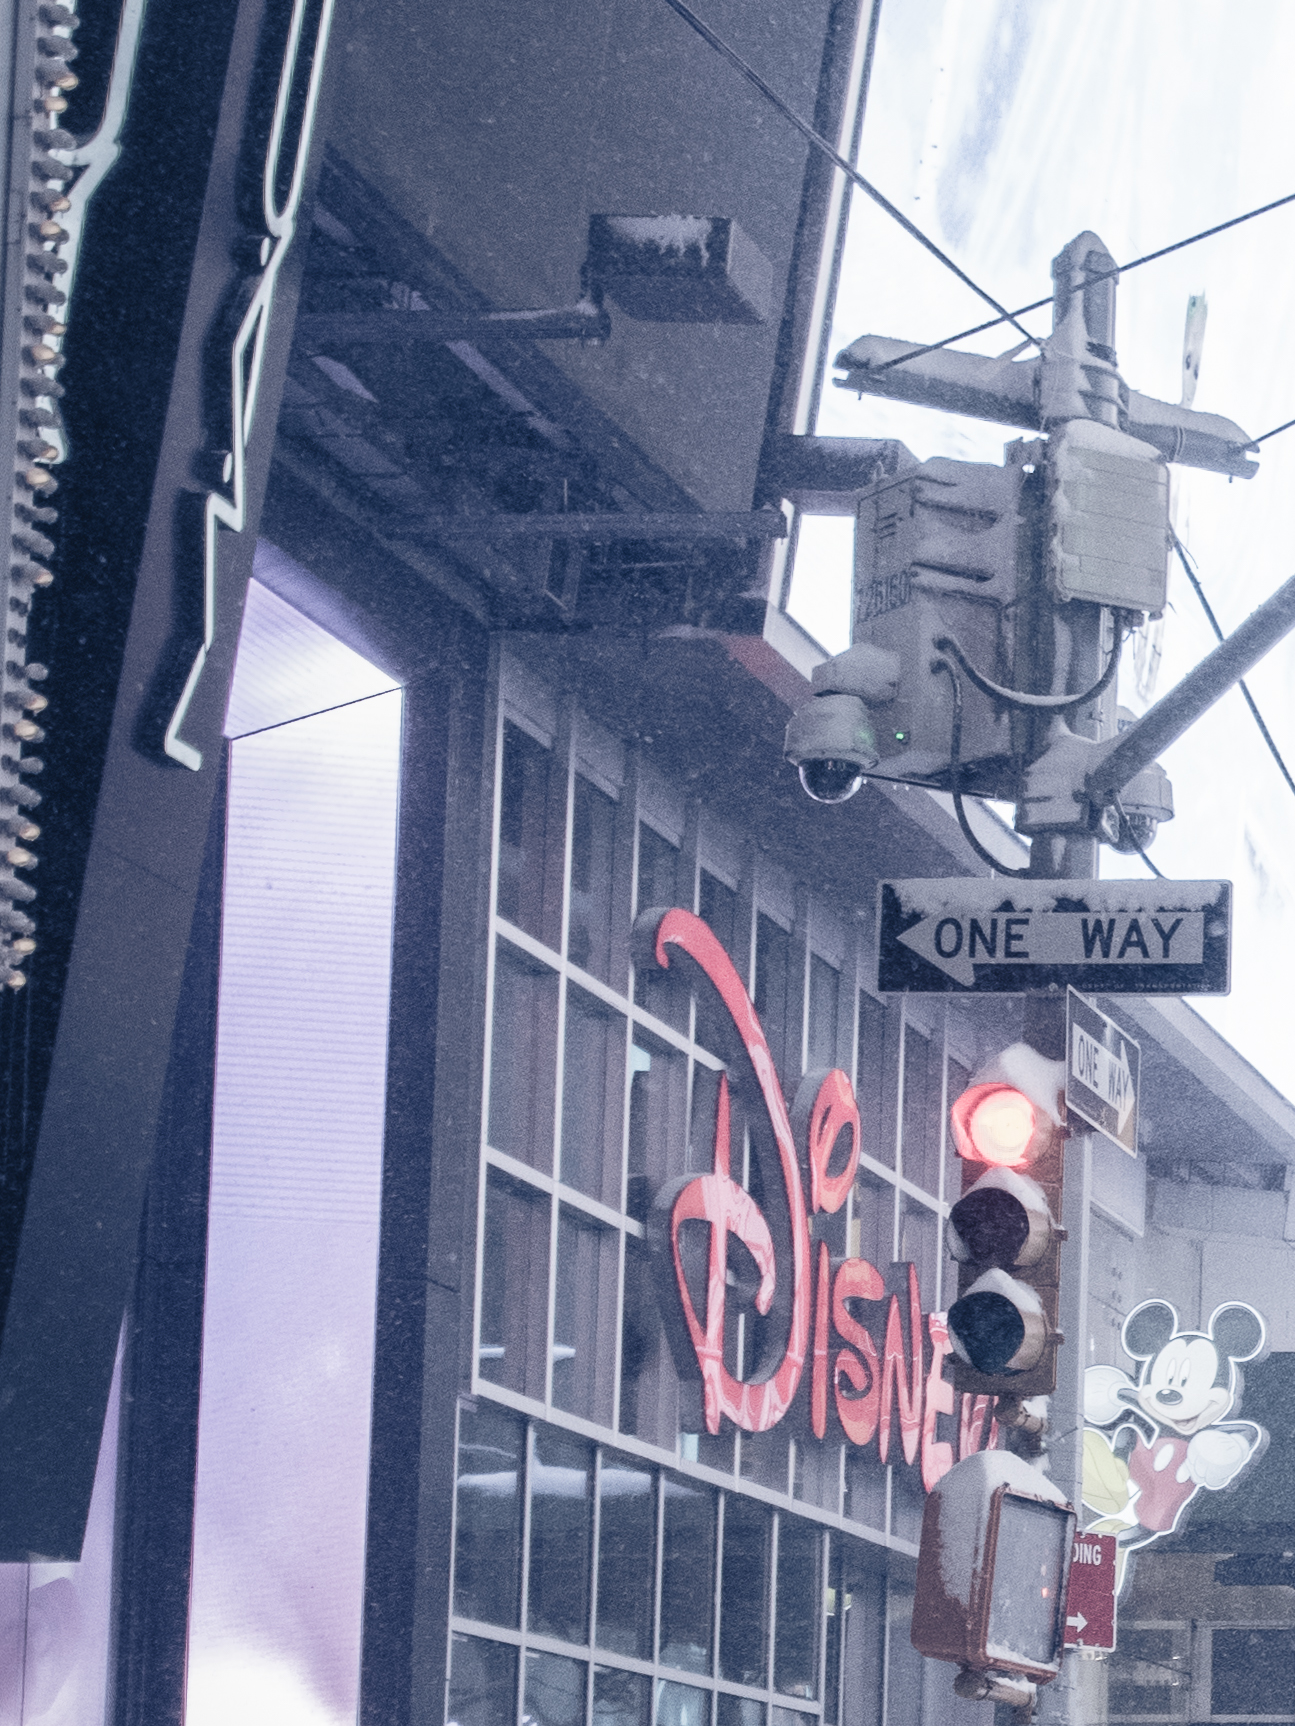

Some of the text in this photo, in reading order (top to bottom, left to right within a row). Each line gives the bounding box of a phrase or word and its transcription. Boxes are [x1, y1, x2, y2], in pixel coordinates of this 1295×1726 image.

[933, 917, 1185, 959] ONE WAY
[1077, 1034, 1130, 1112] ONE WAY
